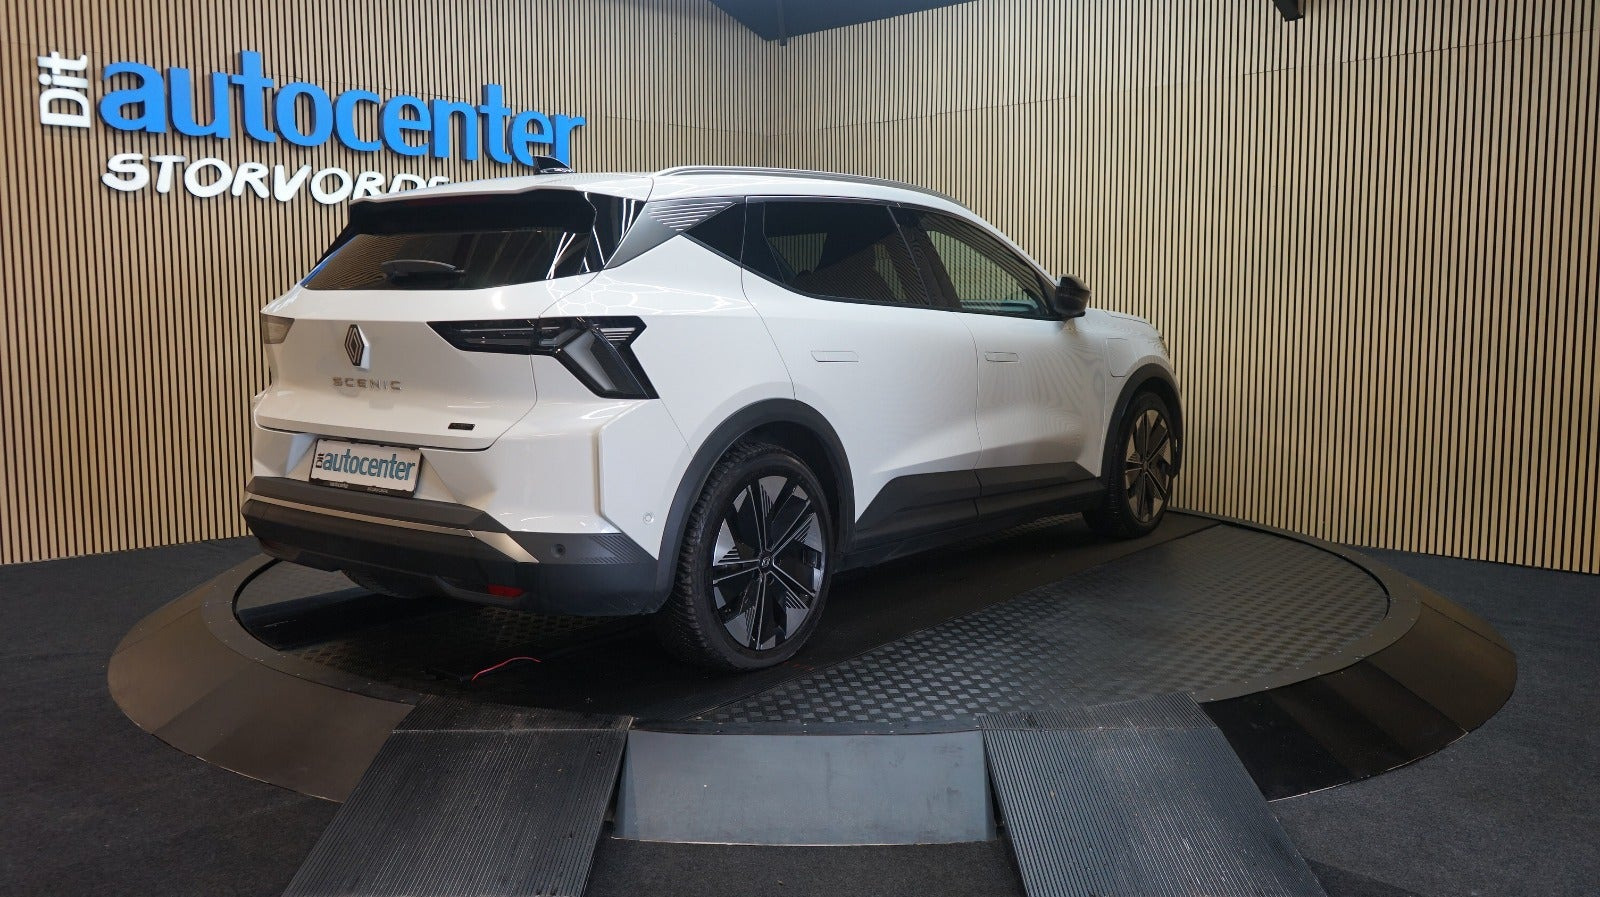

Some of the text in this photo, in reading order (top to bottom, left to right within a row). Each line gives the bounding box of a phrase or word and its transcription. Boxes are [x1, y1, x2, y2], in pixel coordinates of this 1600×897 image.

[37, 50, 586, 166] Dit autocenter
[101, 152, 450, 205] STORVORD
[332, 376, 402, 390] SCENIC
[315, 449, 416, 481] Dit autocenter
